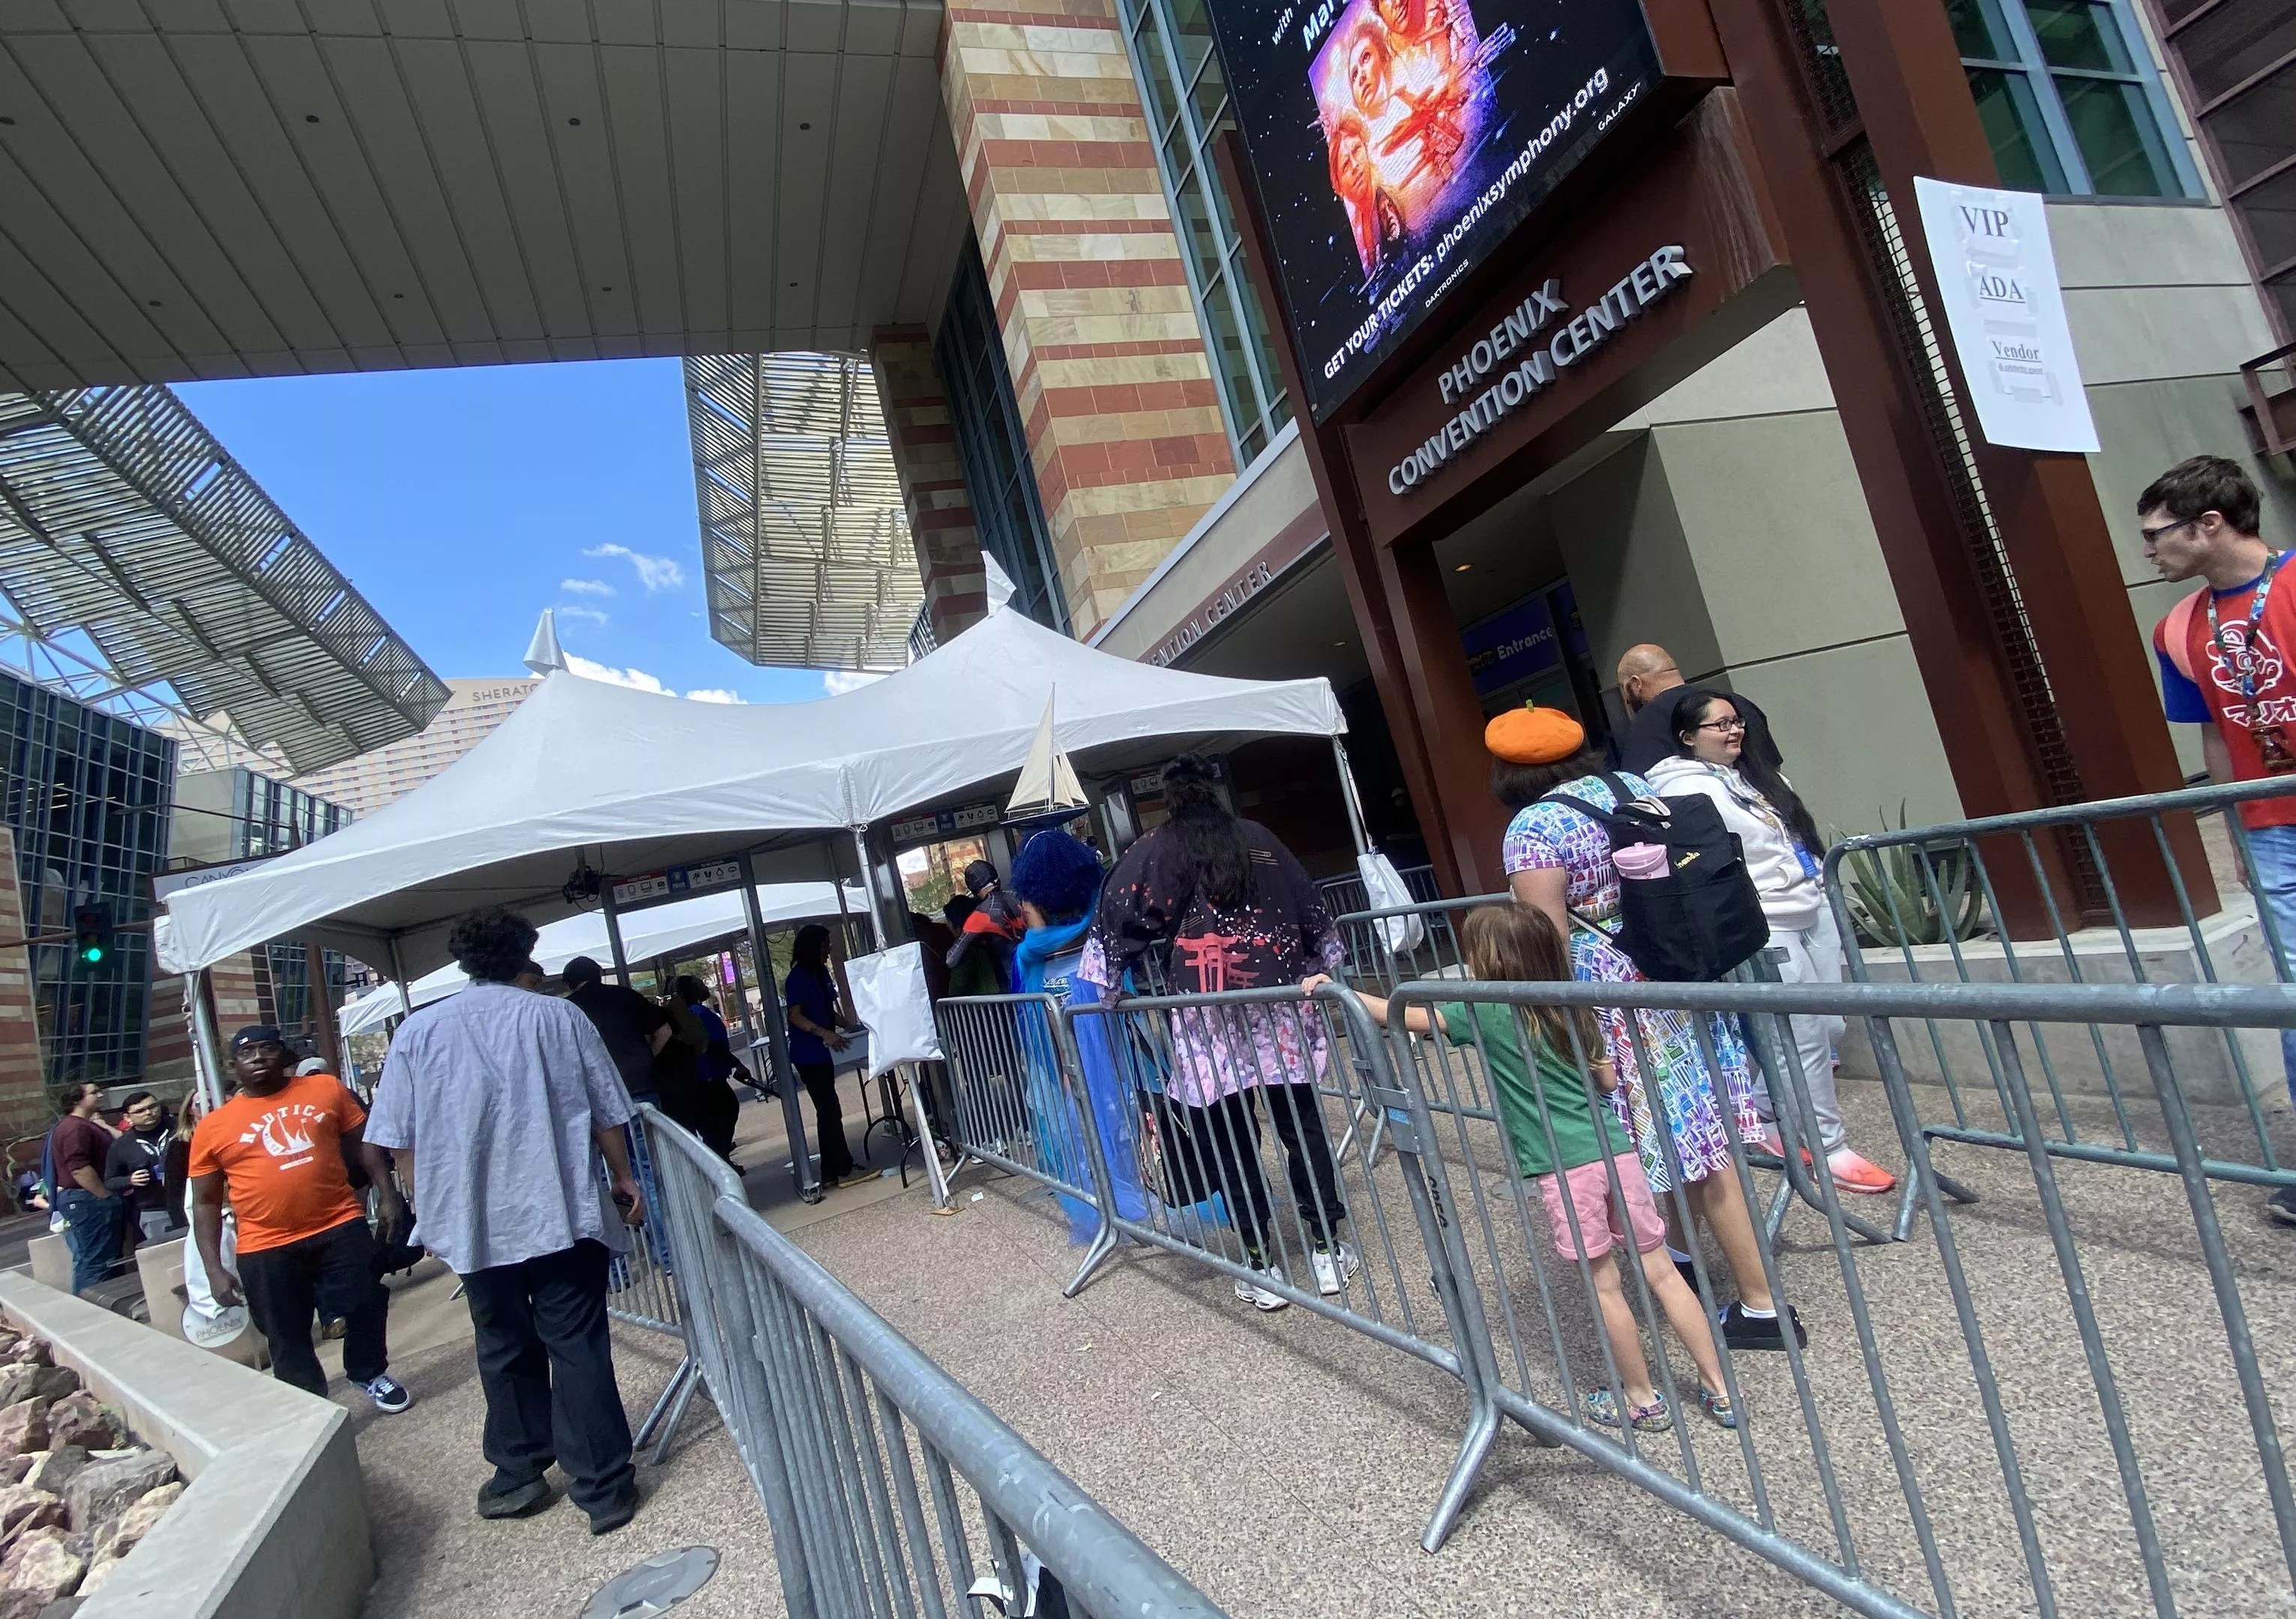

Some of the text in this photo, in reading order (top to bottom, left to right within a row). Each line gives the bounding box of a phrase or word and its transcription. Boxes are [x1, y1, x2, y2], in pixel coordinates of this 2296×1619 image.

[1272, 7, 1294, 45] with
[1597, 83, 1640, 131] GALAXY
[1325, 66, 1609, 379] GET YOUR TICKETS: phoenixsymphony.org
[1959, 205, 2009, 238] VIP
[1425, 259, 1469, 308] DAKTRONICS
[1980, 275, 2025, 301] ADA
[1438, 279, 1569, 405] PHOENIX
[1991, 340, 2039, 360] Vendor
[1388, 245, 1693, 495] CONVENTION CENTER
[1205, 561, 1271, 624] CENTER
[1497, 626, 1553, 660] Entrance
[239, 1103, 325, 1144] NAUTICA
